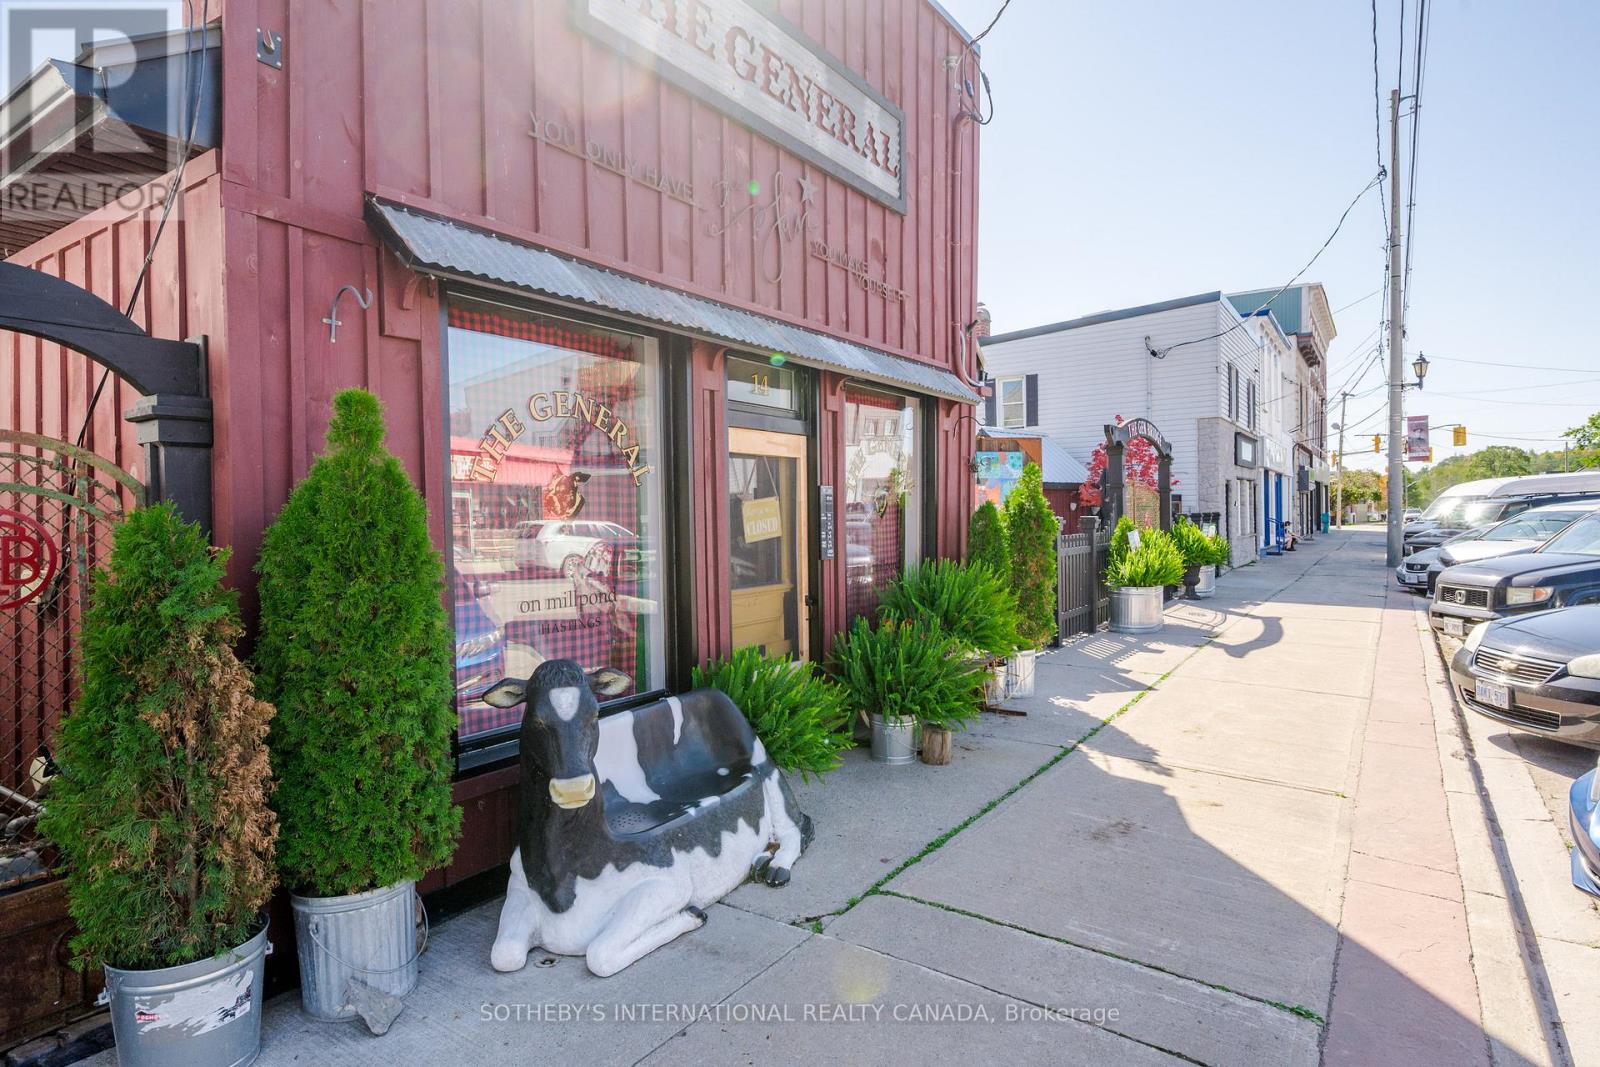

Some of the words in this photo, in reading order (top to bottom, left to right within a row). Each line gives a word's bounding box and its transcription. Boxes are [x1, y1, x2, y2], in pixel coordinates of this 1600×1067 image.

[725, 25, 899, 178] GENERAL
[646, 167, 694, 199] HAVE
[751, 373, 769, 395] 14
[469, 408, 526, 483] THE
[529, 391, 650, 486] GENERAL
[519, 599, 541, 613] on
[541, 617, 601, 634] HASTINGS
